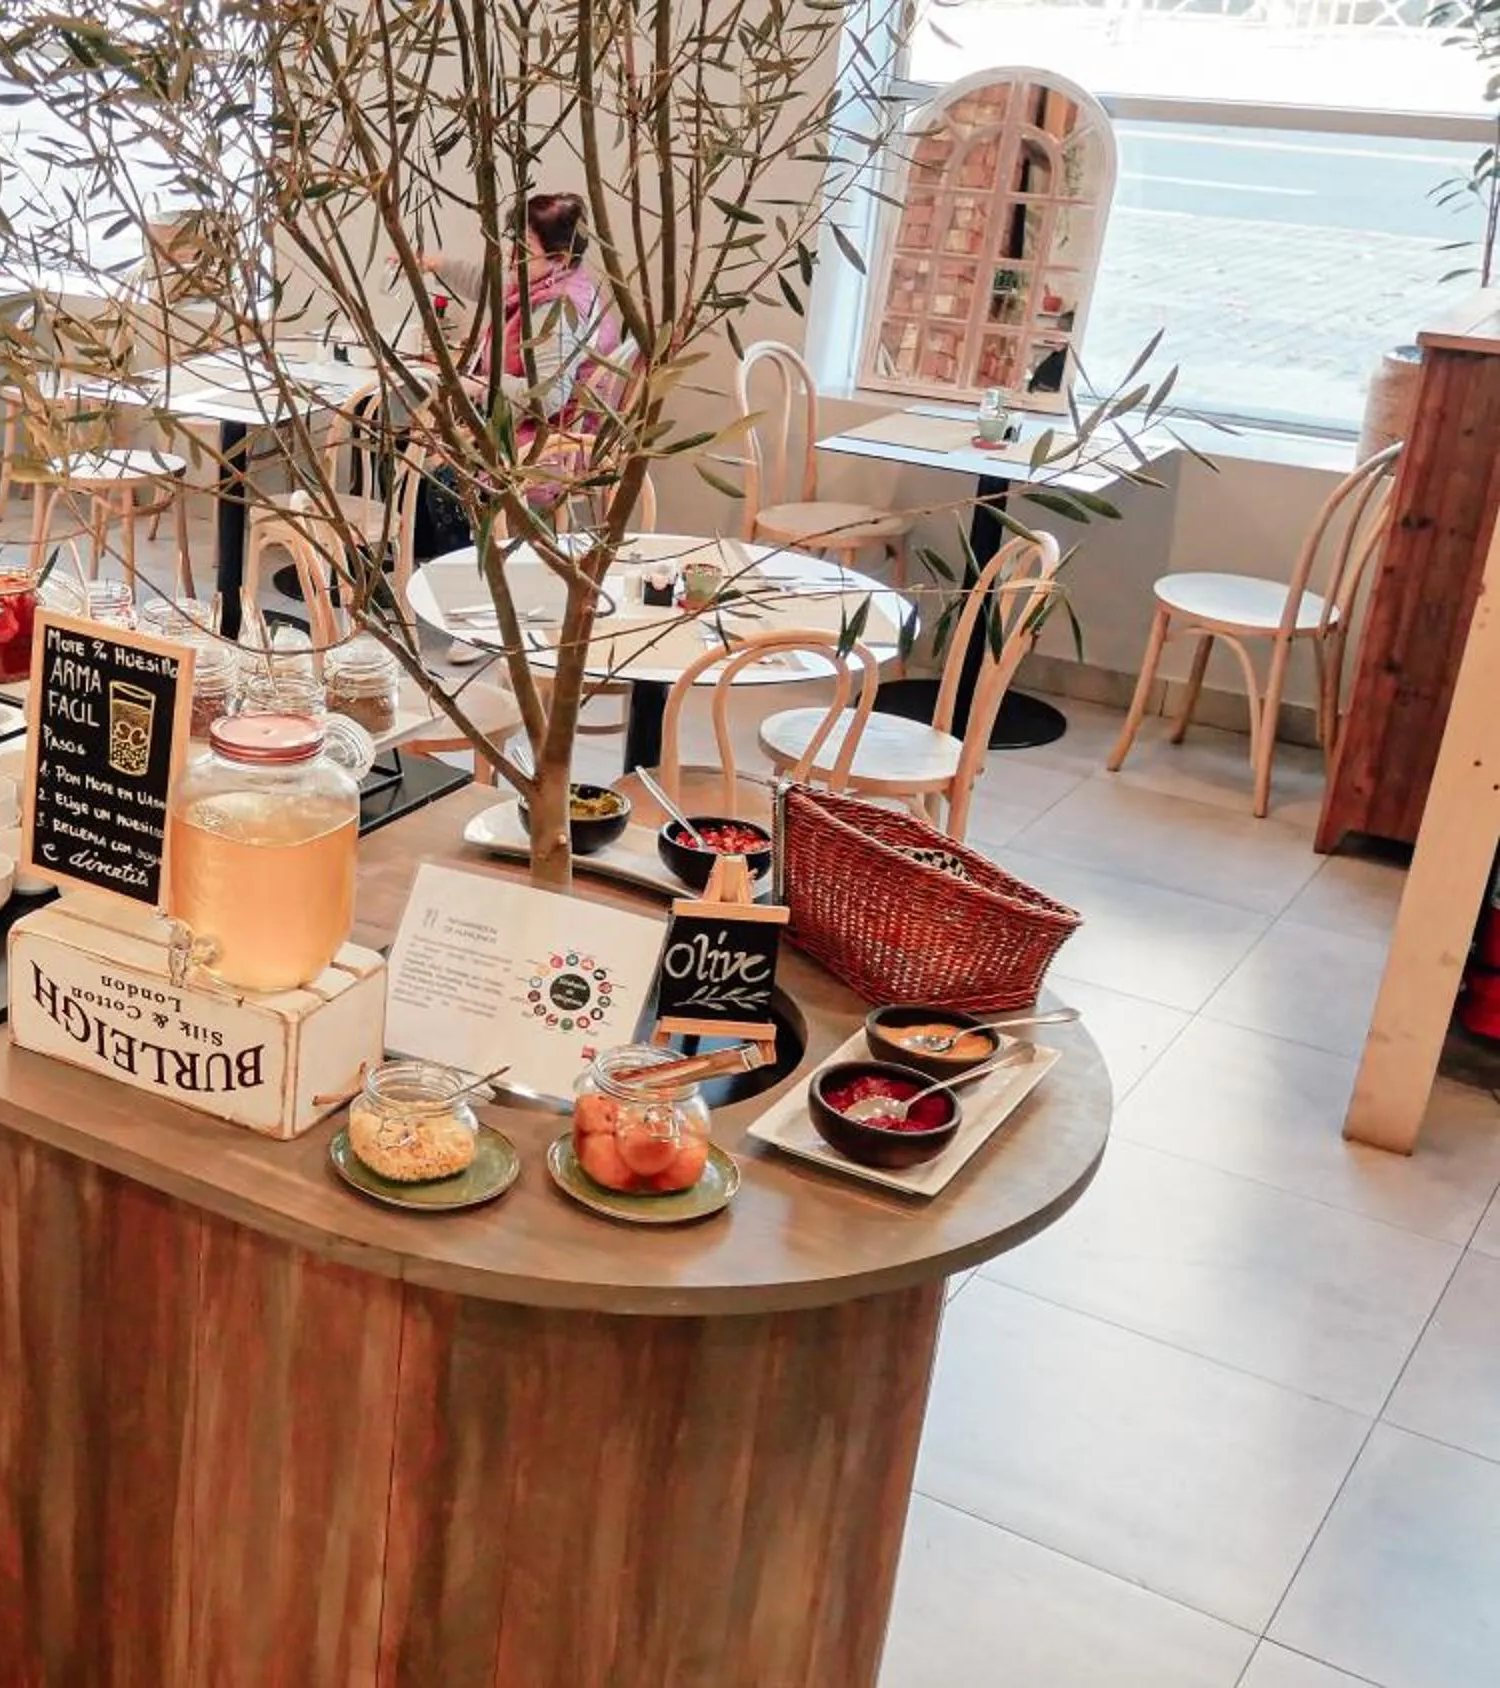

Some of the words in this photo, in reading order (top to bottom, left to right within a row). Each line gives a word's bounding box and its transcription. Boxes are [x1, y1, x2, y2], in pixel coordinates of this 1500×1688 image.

[49, 656, 102, 693] ARMA
[665, 929, 771, 984] Olive
[71, 986, 142, 1021] Cotton
[100, 975, 182, 1013] London
[30, 960, 265, 1093] BURLEIGH
[152, 1012, 170, 1029] &
[179, 1022, 224, 1047] Silk
